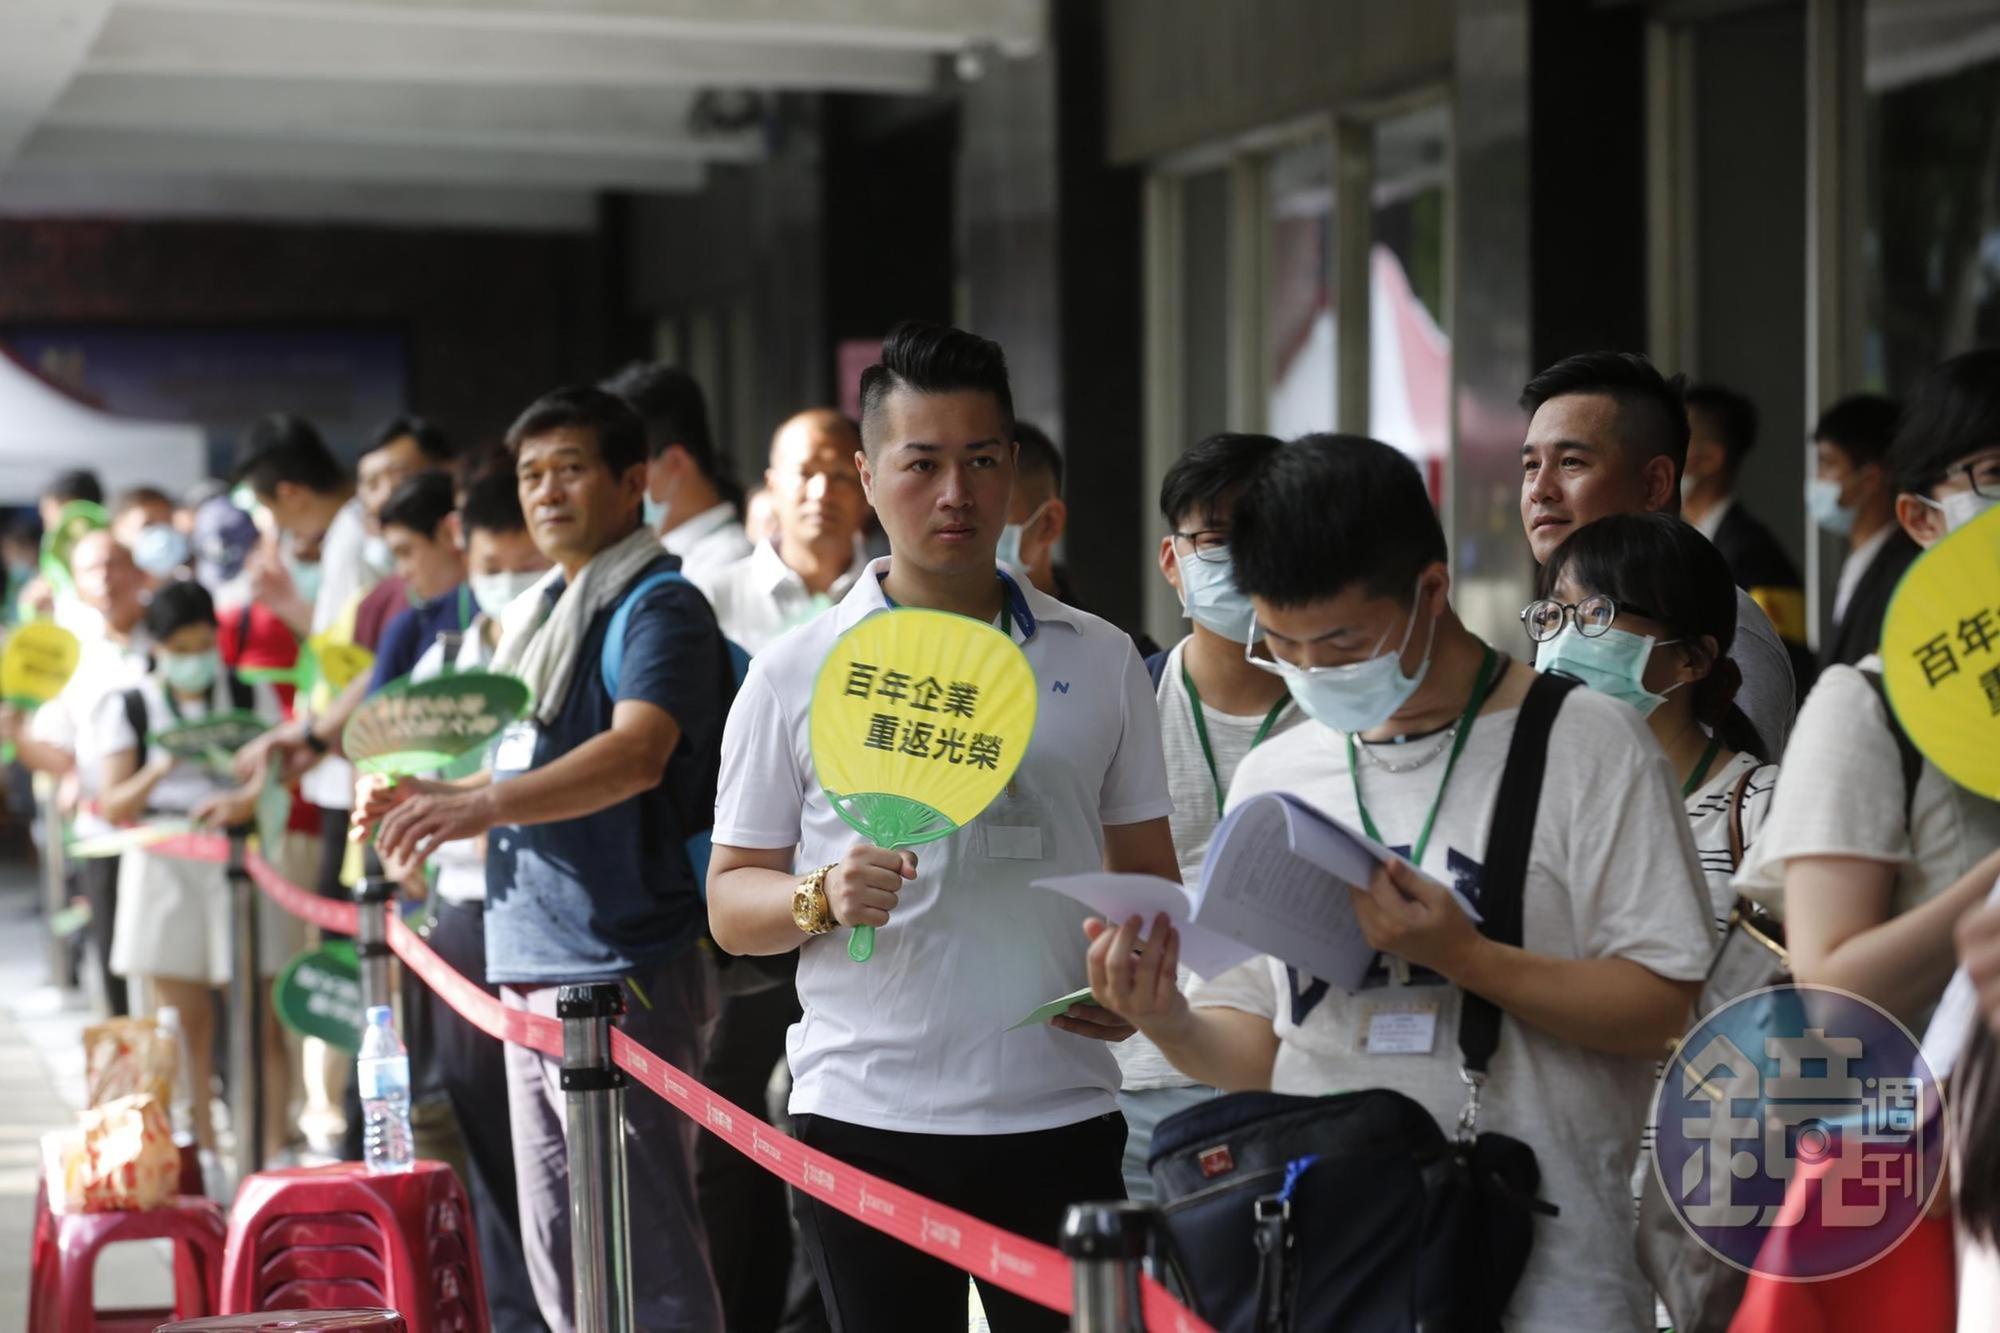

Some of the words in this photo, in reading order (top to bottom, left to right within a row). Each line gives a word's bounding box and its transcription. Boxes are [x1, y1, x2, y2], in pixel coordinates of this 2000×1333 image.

[1912, 608, 2000, 690] 百年
[843, 661, 980, 719] 百年企業
[863, 713, 1003, 771] 重返光榮
